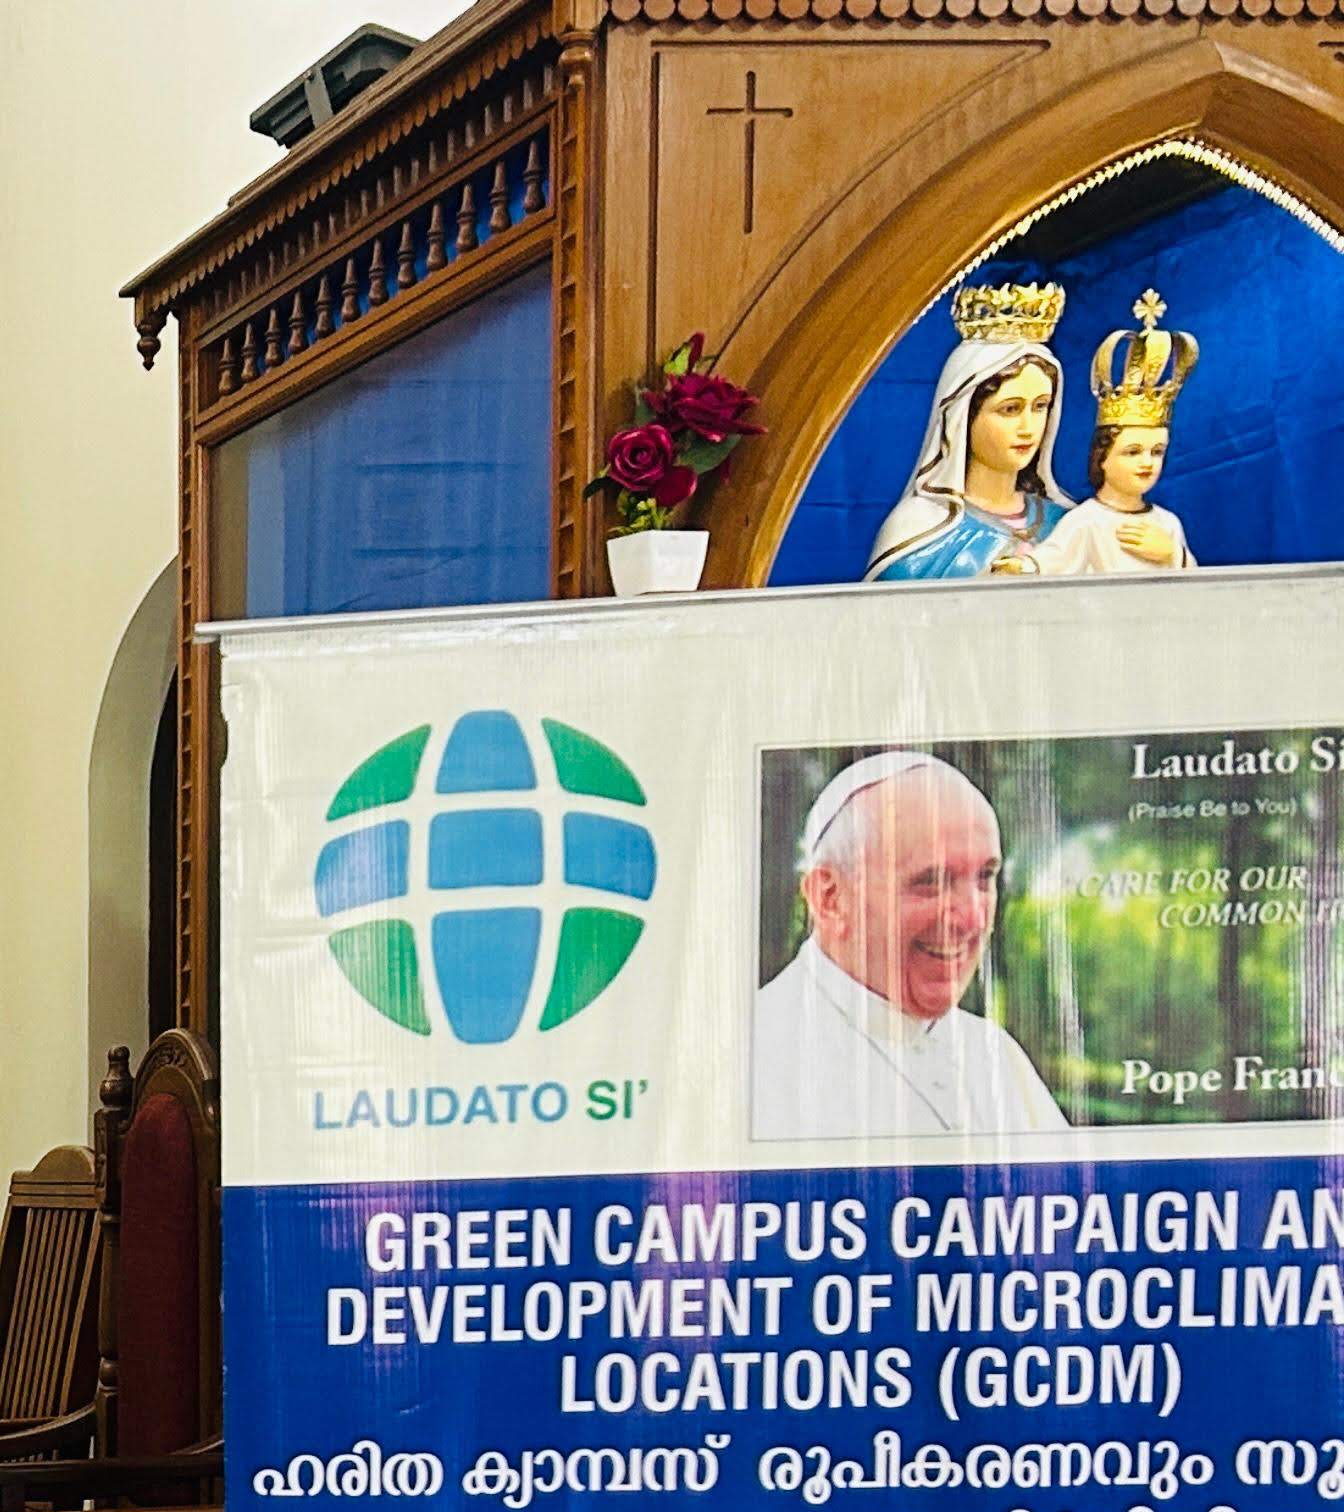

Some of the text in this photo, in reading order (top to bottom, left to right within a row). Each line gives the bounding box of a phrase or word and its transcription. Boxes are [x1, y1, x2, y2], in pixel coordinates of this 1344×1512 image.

[1130, 739, 1300, 780] Laudato
[1128, 798, 1297, 824] (Praise Be to You)
[1169, 867, 1232, 894] FOR
[1238, 865, 1308, 892] OUR
[1159, 899, 1307, 929] COMMON
[1121, 1058, 1223, 1105] Pope
[314, 1081, 569, 1131] LAUDATO
[365, 1208, 571, 1274] GREEN
[594, 1198, 867, 1266] CAMPUS
[891, 1190, 1239, 1259] CAMPAIGN
[327, 1264, 1344, 1346] DEVELOPMENT OF MICROCLIMA
[561, 1342, 1181, 1421] LOCATIONS (GCDM)
[253, 1440, 444, 1497] ഹരിത
[462, 1433, 731, 1509] ക്യാമ്പസ്
[758, 1430, 1214, 1505] രൂപീകരണവും
